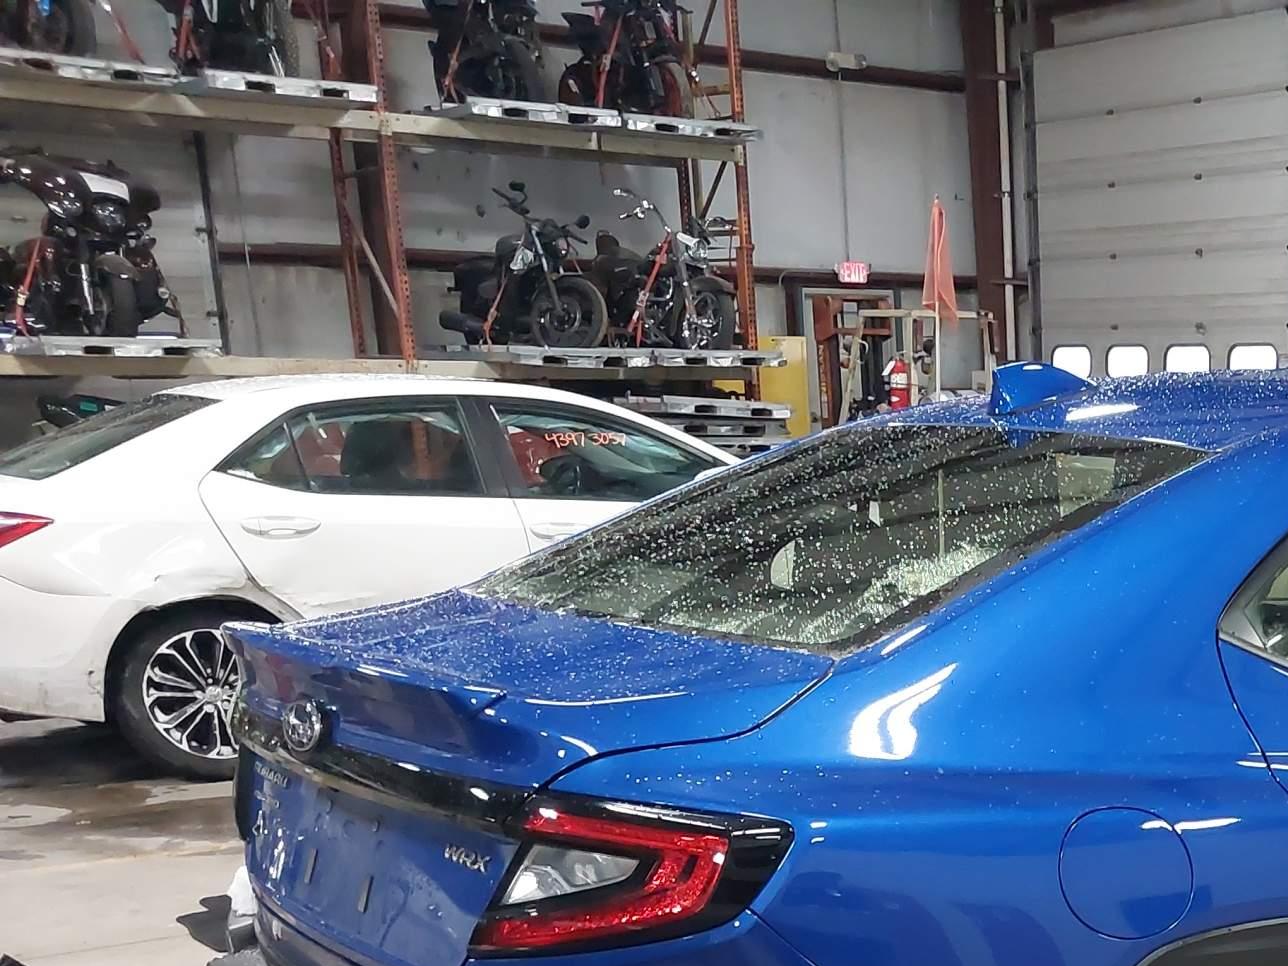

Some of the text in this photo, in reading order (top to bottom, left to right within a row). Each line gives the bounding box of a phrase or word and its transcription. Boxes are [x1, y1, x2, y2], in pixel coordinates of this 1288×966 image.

[843, 262, 866, 283] EXIT
[544, 431, 585, 448] 4397
[444, 844, 491, 873] WRX
